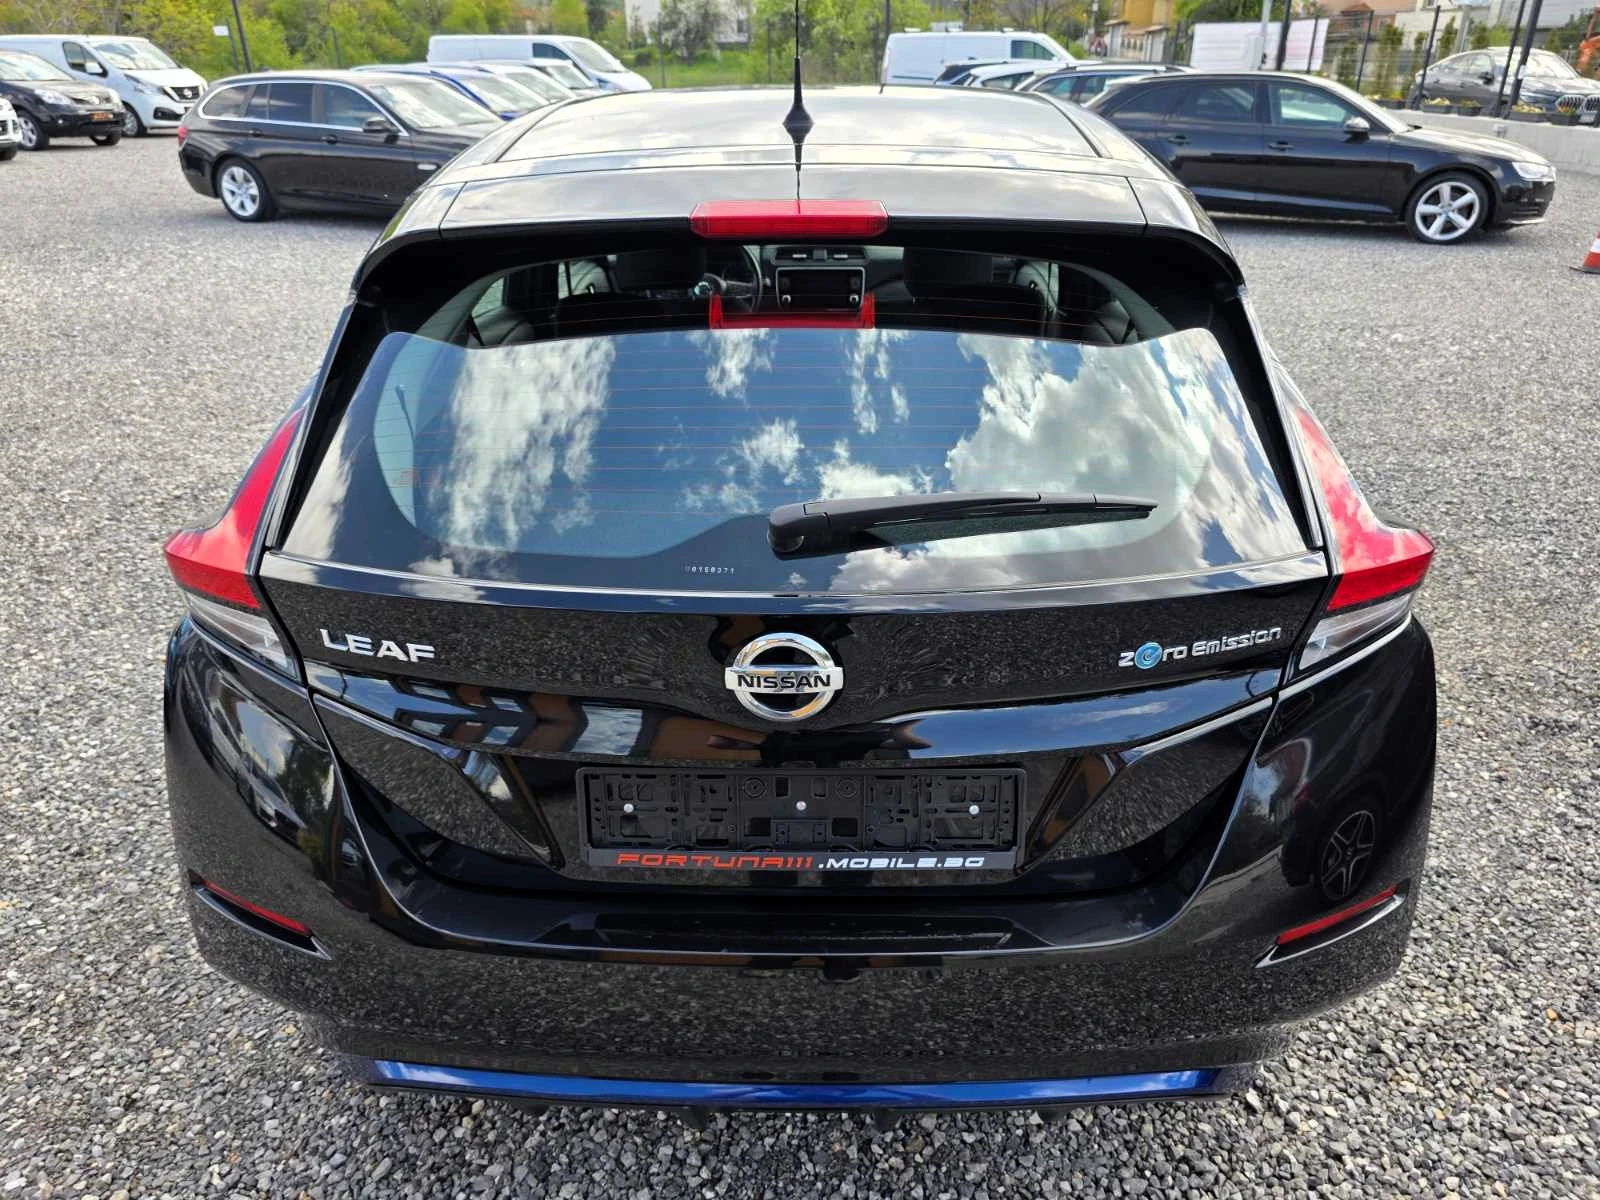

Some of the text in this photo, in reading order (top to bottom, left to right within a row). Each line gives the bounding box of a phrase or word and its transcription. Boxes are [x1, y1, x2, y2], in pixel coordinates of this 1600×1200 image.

[320, 628, 436, 663] LEAF
[1191, 626, 1282, 656] Emission
[737, 674, 831, 689] NISSAN
